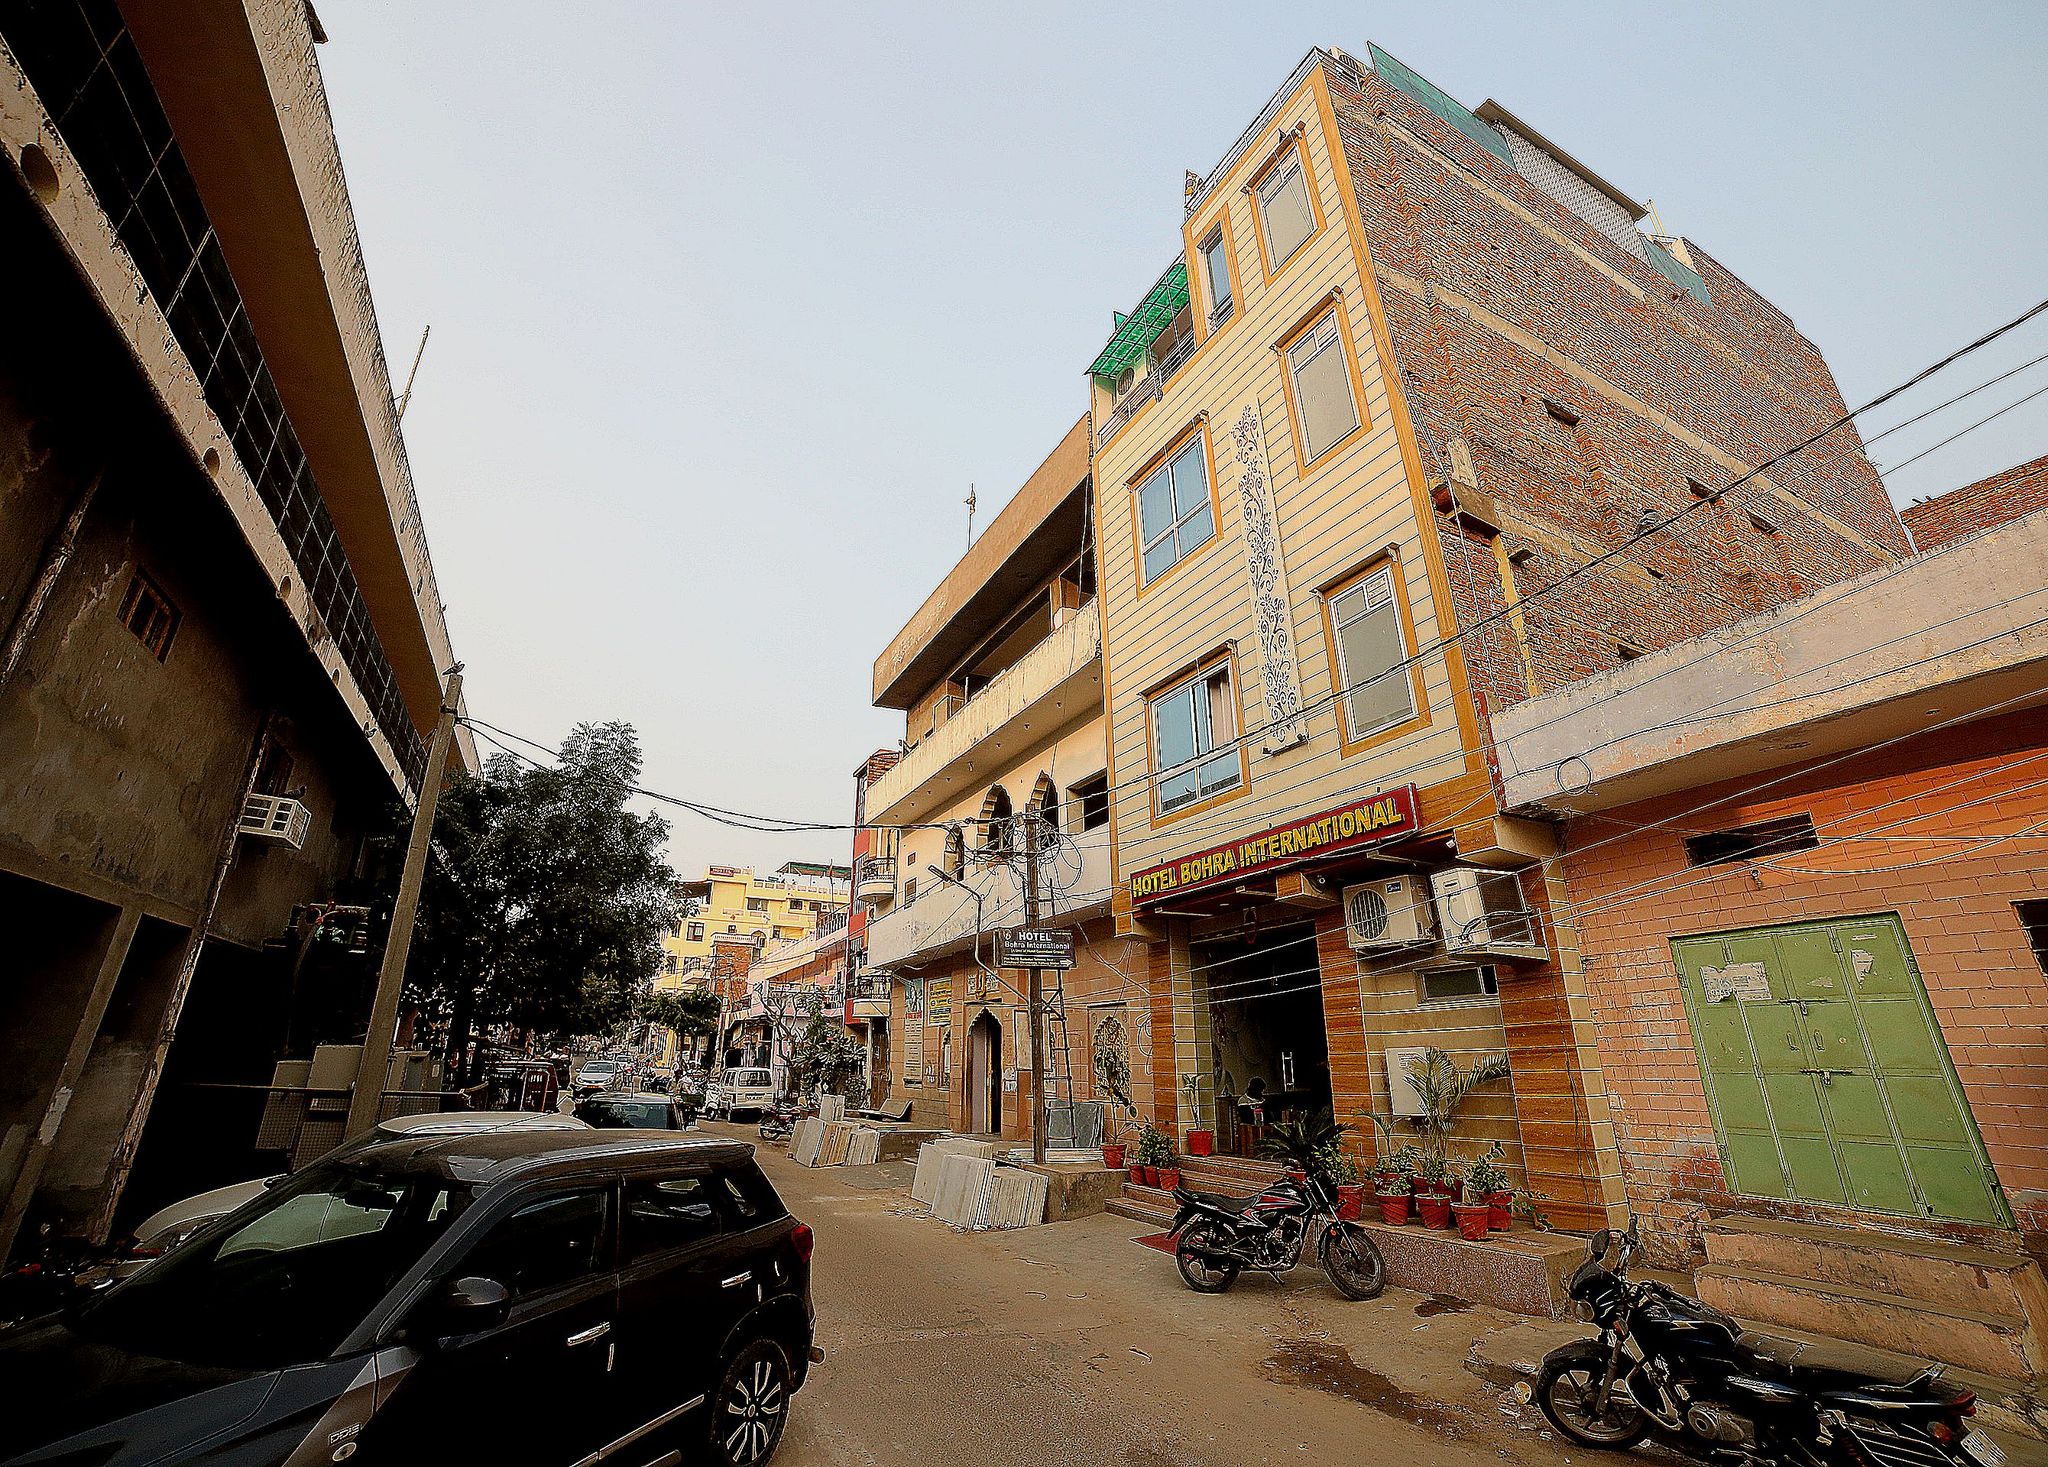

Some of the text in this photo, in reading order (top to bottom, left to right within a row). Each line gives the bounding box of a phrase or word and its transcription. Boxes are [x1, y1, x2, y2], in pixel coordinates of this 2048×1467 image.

[1133, 797, 1402, 897] HOTEL BOHRA INTERNATIONAL
[1018, 931, 1051, 941] HOTEL
[1026, 941, 1070, 950] International
